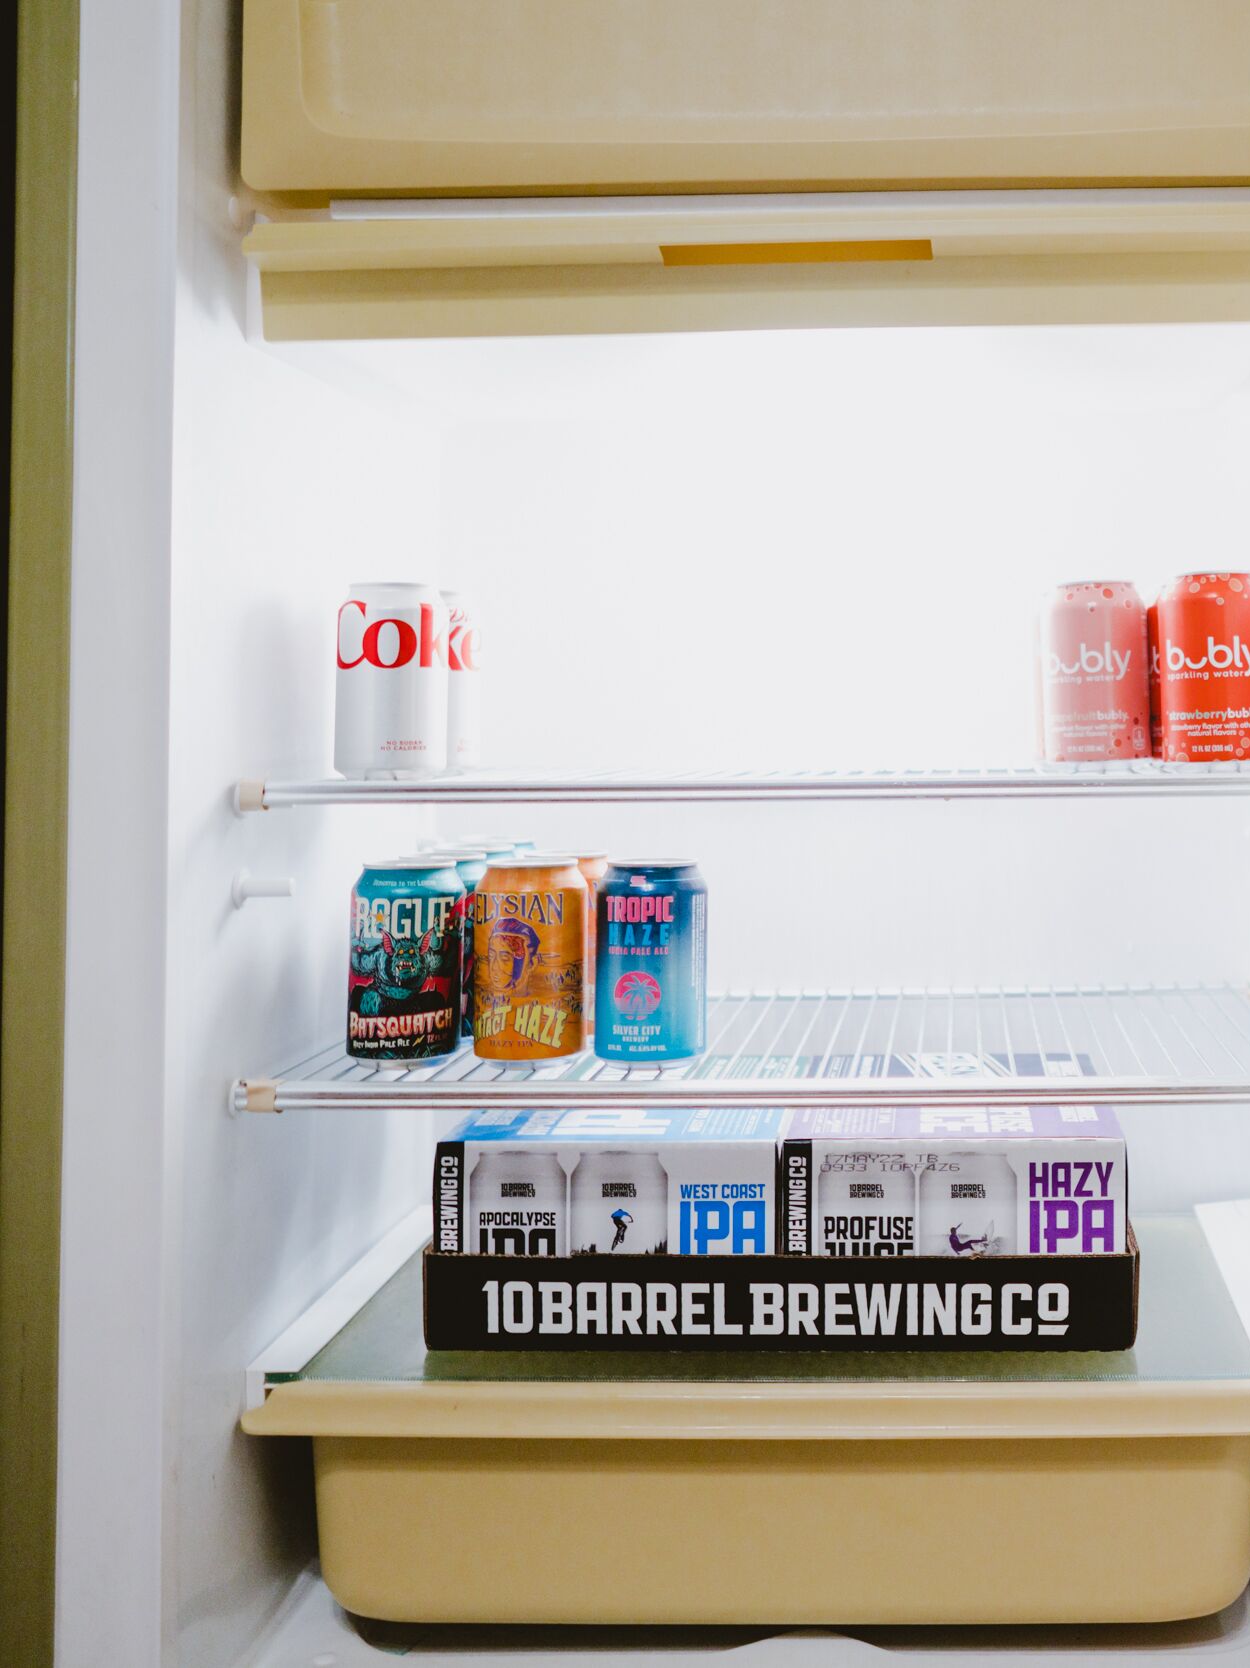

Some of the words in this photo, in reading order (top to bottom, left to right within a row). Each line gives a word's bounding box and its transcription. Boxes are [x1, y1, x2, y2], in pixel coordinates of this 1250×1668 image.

[336, 600, 448, 670] Cok
[1213, 670, 1243, 678] water
[354, 896, 455, 939] ROGUE
[475, 892, 564, 926] ELYSIAN
[606, 896, 675, 922] TROPIC
[608, 923, 670, 946] HAZE
[349, 1008, 453, 1039] BATSQUATCH
[514, 1004, 568, 1049] HAZE
[612, 1025, 639, 1036] SILVER
[820, 1163, 867, 1173] 0933
[823, 1154, 905, 1164] 17MAY22
[680, 1184, 718, 1199] WEST
[721, 1184, 765, 1199] COAST
[1029, 1162, 1114, 1198] HAZY
[440, 1178, 459, 1252] BREWING
[479, 1212, 556, 1226] APOCALYPSE
[679, 1200, 766, 1255] IPA
[824, 1216, 914, 1240] PROFUSE
[1029, 1199, 1115, 1254] IPA
[749, 1282, 993, 1336] BREWING
